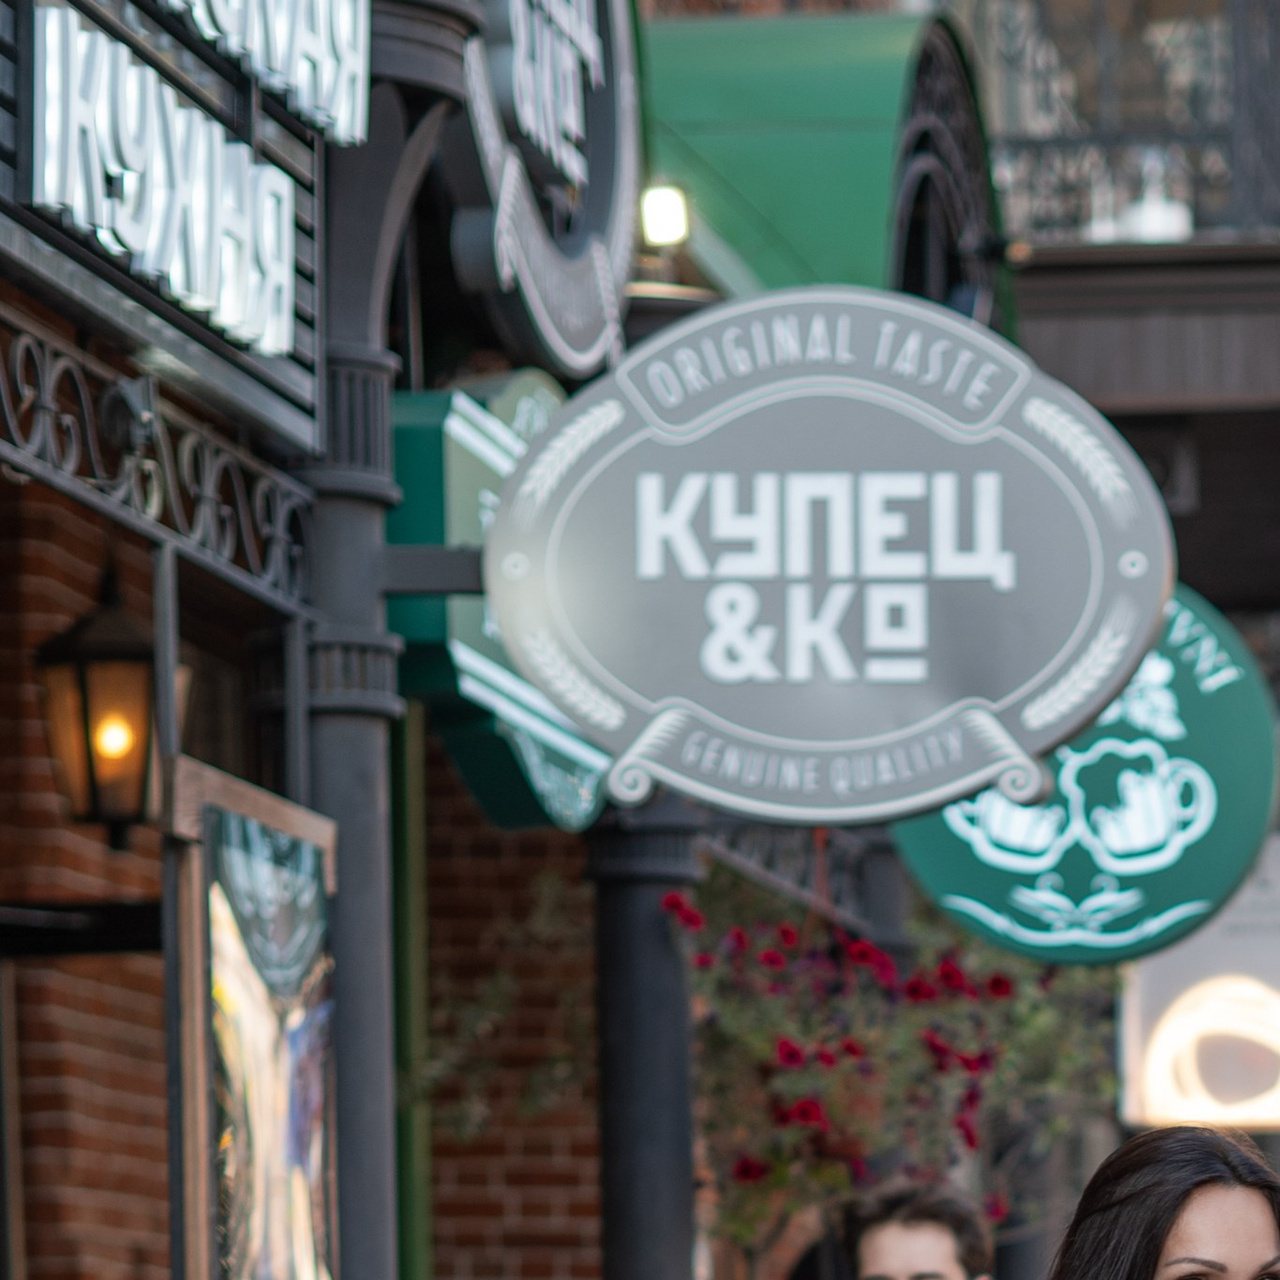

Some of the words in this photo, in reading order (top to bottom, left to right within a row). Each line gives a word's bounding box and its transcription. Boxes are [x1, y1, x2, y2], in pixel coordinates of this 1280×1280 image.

[33, 4, 296, 357] КУХНЯ
[646, 312, 857, 409] ORIGINAL
[874, 319, 1002, 412] TASTE
[635, 470, 1016, 591] КУПЕЦ
[1162, 599, 1246, 694] VNI
[680, 729, 822, 795] GENUINE
[828, 726, 965, 800] QUALITY
